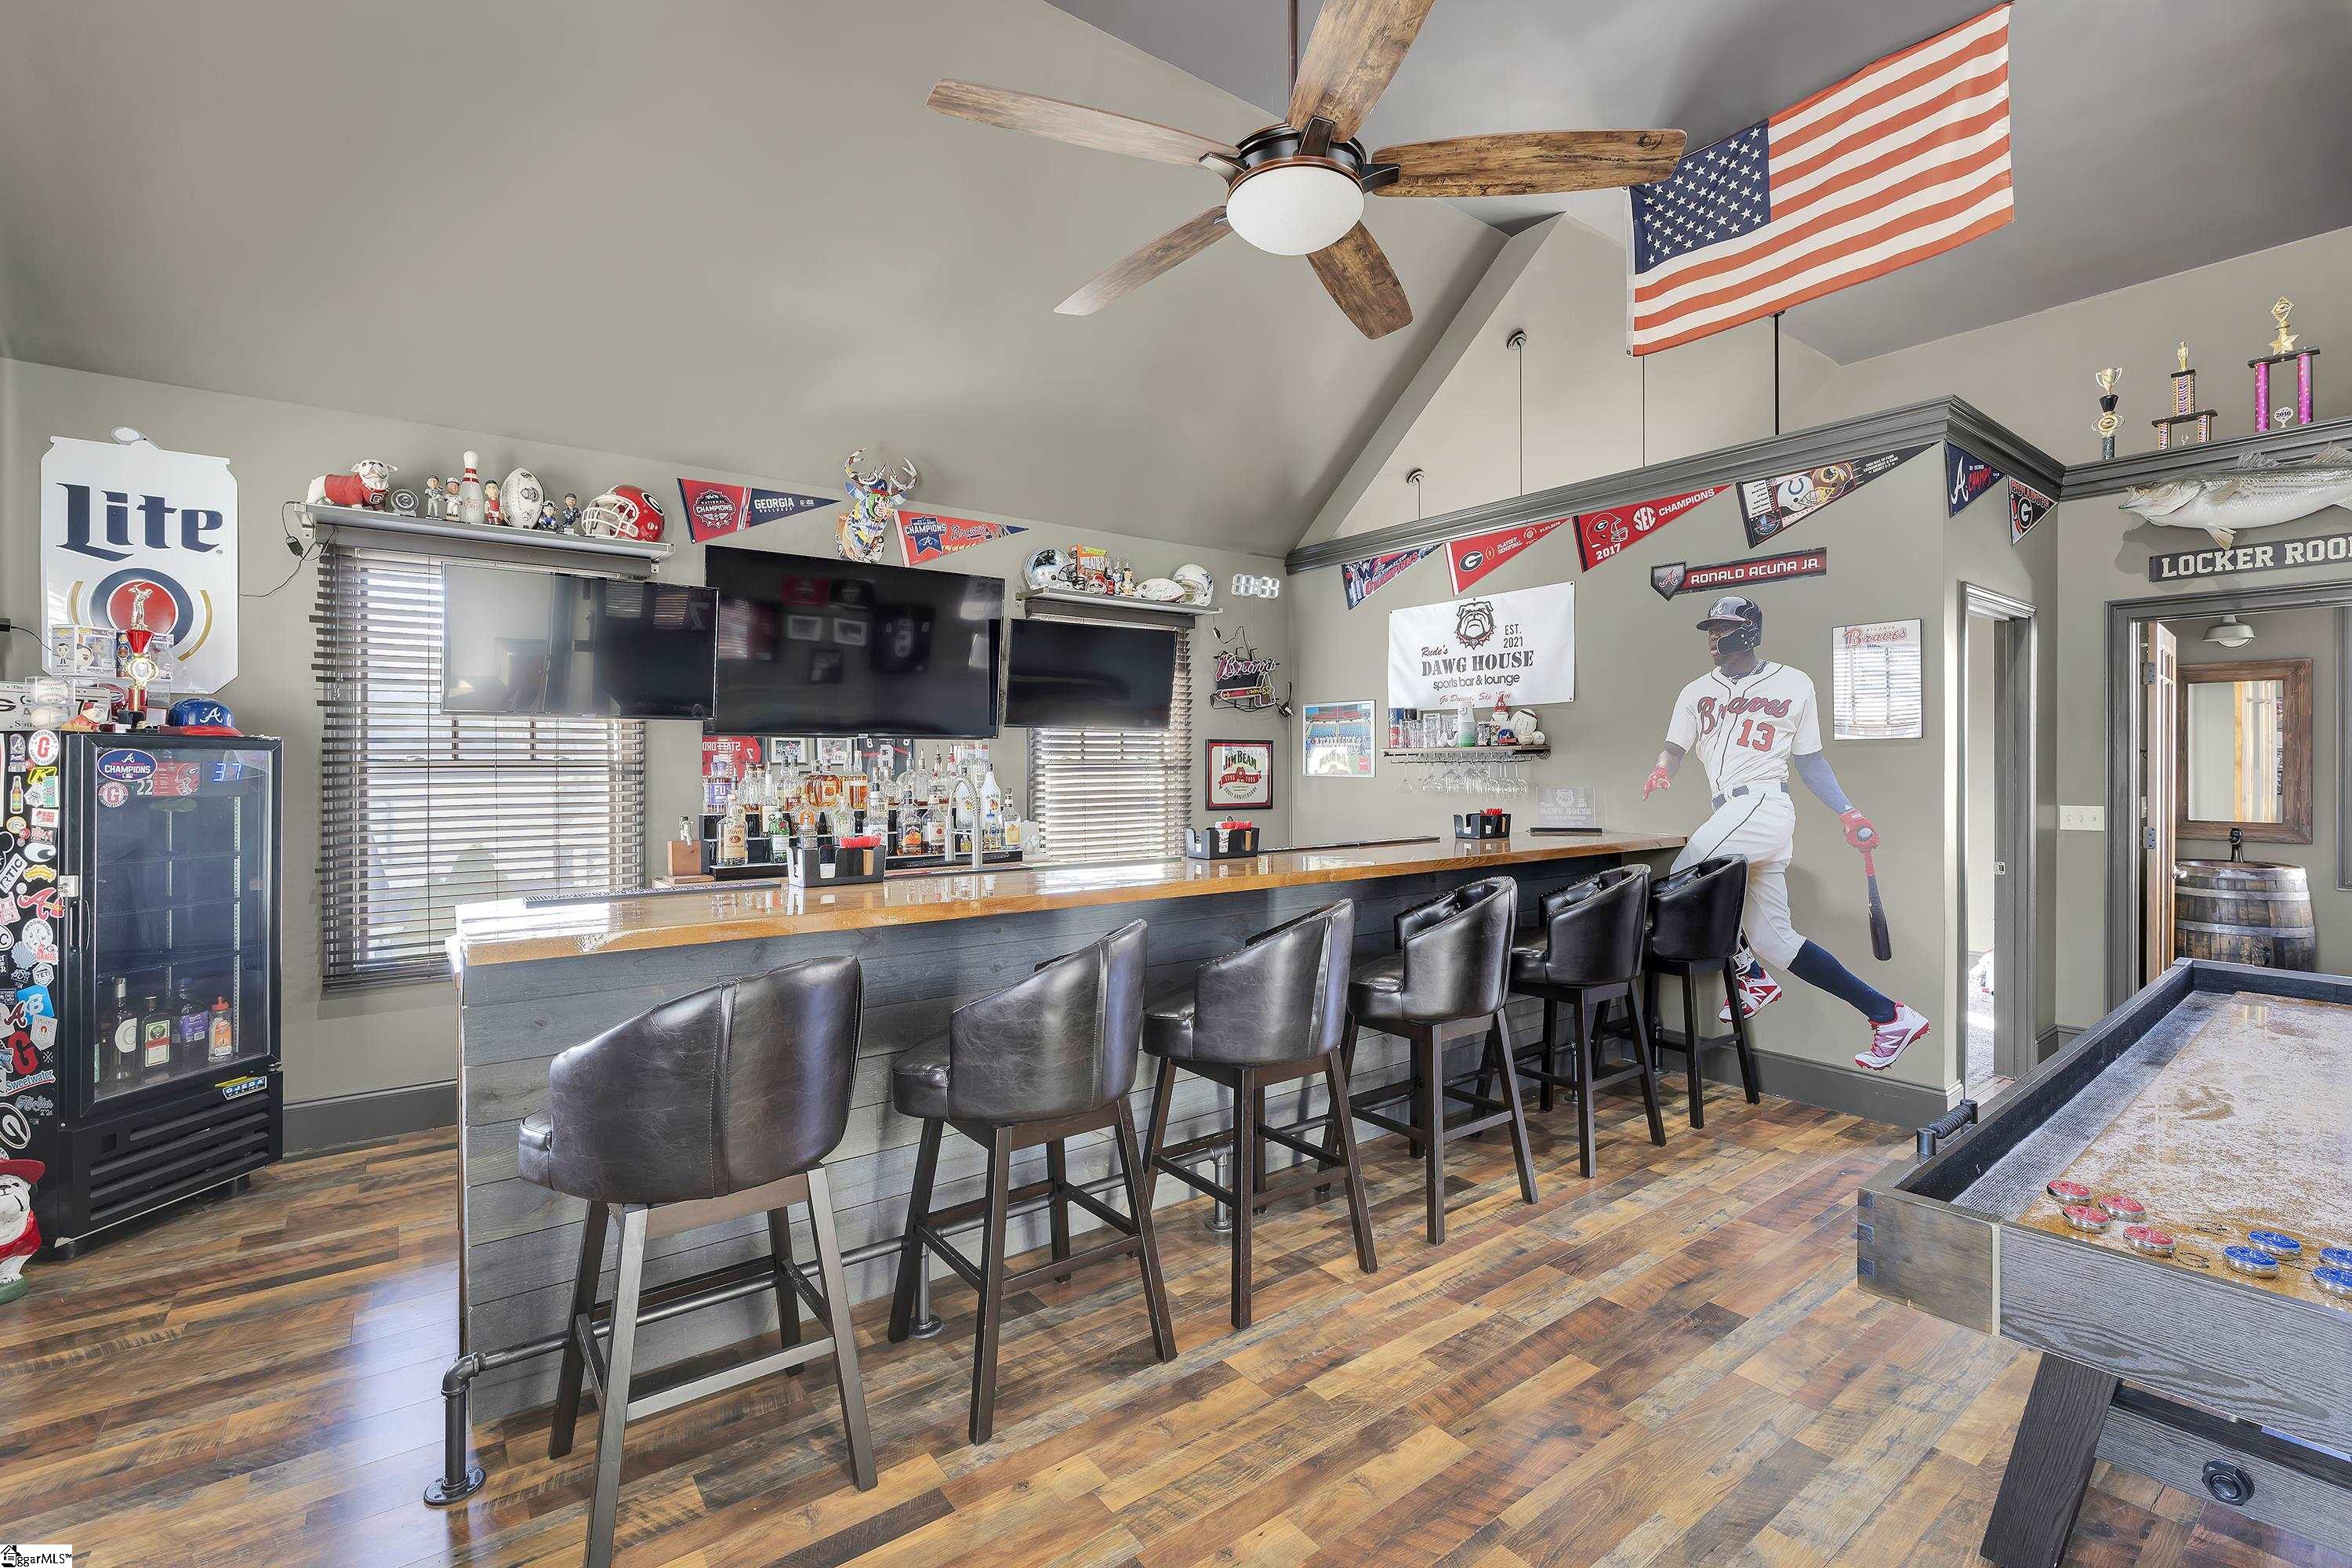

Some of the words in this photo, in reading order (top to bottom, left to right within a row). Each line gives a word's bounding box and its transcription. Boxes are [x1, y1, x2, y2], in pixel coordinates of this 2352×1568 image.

[754, 497, 795, 510] GEORGIA
[1658, 488, 1715, 517] CHAMPIONS
[2011, 479, 2050, 510] BULLDOGS
[695, 504, 733, 514] CHAMPIONS
[56, 482, 223, 562] Lite
[1632, 505, 1657, 532] SEC
[904, 524, 947, 535] CHAMPIONS
[1497, 536, 1518, 550] PLAYOFF
[1497, 540, 1523, 554] SEMIFINAL
[1595, 543, 1621, 561] 2017
[2161, 546, 2274, 579] LOCKER
[2285, 536, 2352, 565] ROO
[1365, 551, 1418, 596] CHAMPIONS
[1690, 568, 1744, 585] RONALD
[1748, 561, 1797, 577] ACUÑA
[1801, 557, 1821, 571] JR.
[1504, 623, 1522, 636] EST.
[1843, 626, 1907, 649] Braves
[1421, 644, 1449, 658] Rude's
[1503, 636, 1524, 648] 2021
[1421, 657, 1467, 677] DAWG
[1472, 650, 1535, 672] HOUSE
[1433, 677, 1458, 691] sports
[1459, 677, 1475, 688] bar
[1475, 674, 1483, 686] &
[1484, 674, 1520, 687] lounge
[1439, 695, 1449, 706] Go
[200, 706, 223, 724] A
[1697, 696, 1793, 741] Braves
[32, 731, 58, 744] GREENVILLE
[1736, 718, 1777, 753] 13
[104, 764, 151, 774] CHAMPIONS
[1223, 754, 1236, 771] JIM
[1237, 750, 1257, 771] BEAM
[212, 762, 243, 782] 37
[136, 779, 154, 797] 22
[0, 858, 23, 889] RTIC
[6, 1069, 53, 1091] Sweetwater
[226, 1079, 265, 1094] OJEDA
